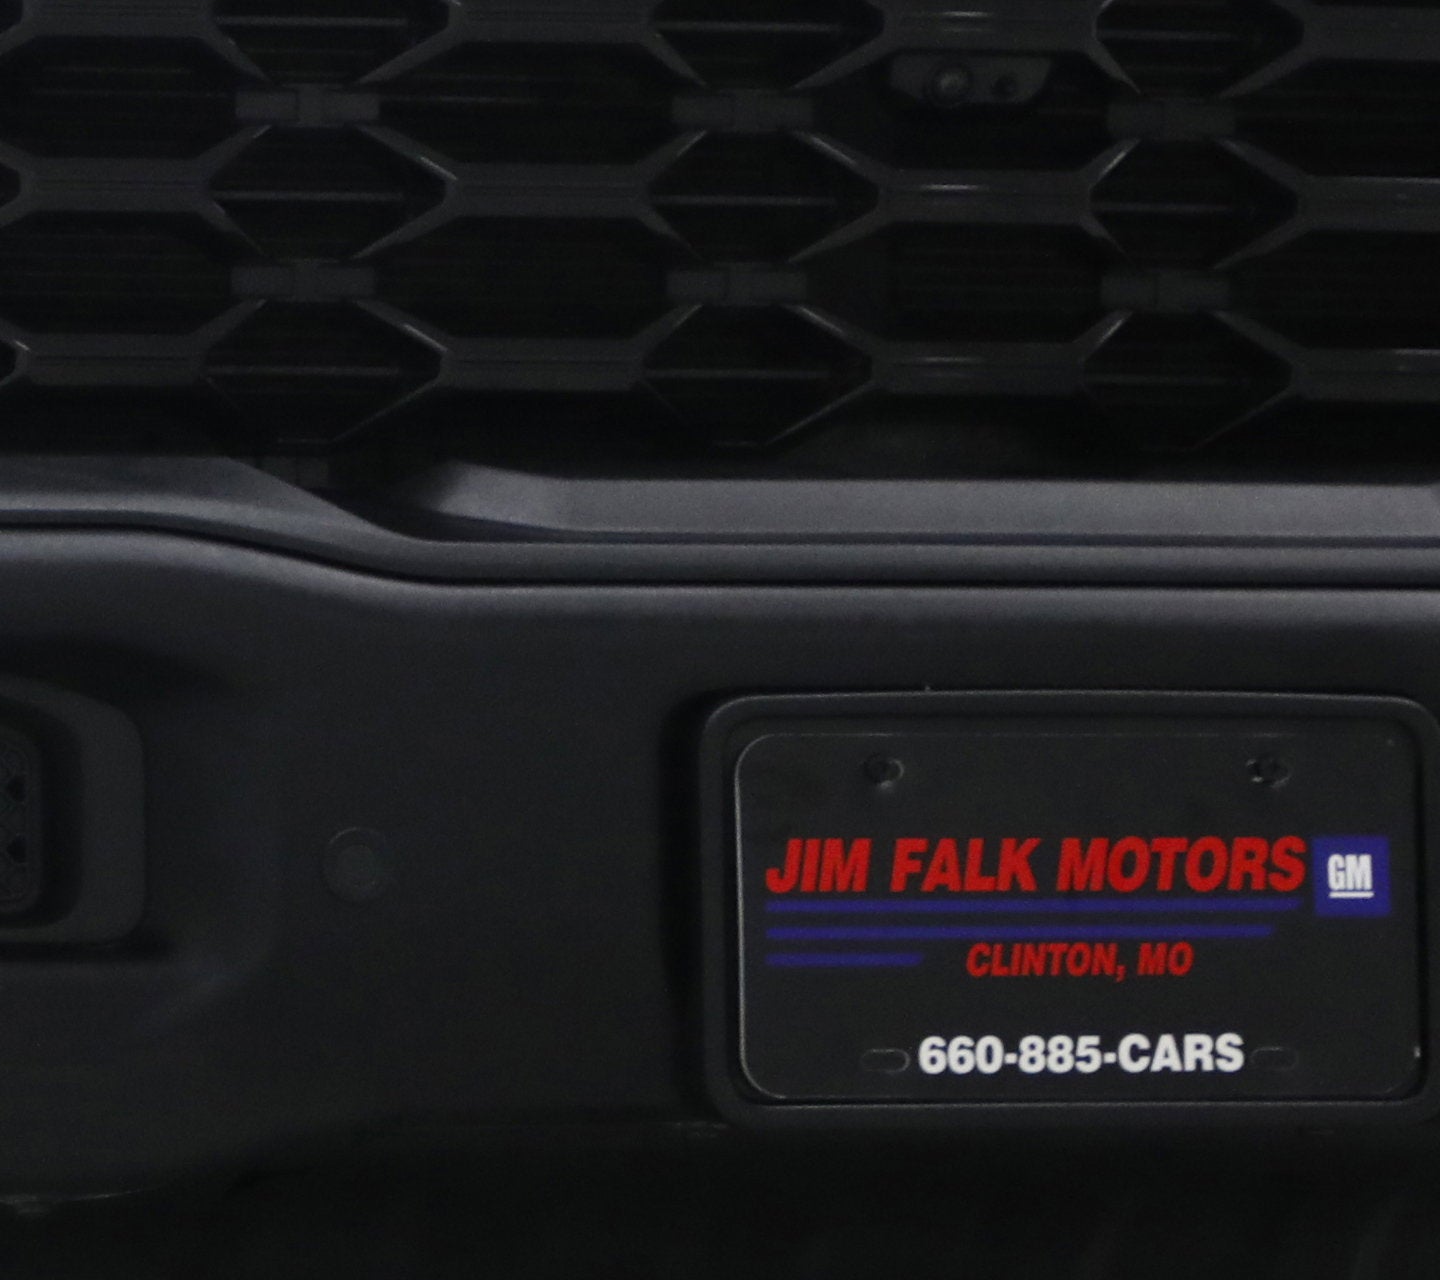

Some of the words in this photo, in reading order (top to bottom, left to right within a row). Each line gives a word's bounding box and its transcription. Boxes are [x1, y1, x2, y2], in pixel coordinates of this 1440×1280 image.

[765, 837, 872, 894] JIM
[890, 837, 1041, 893] FALK
[1056, 835, 1308, 893] MOTORS
[1327, 853, 1373, 890] GM
[965, 941, 1126, 982] CLINTON,
[1136, 941, 1195, 976] MO
[918, 1032, 1245, 1076] 660-885-CARS
